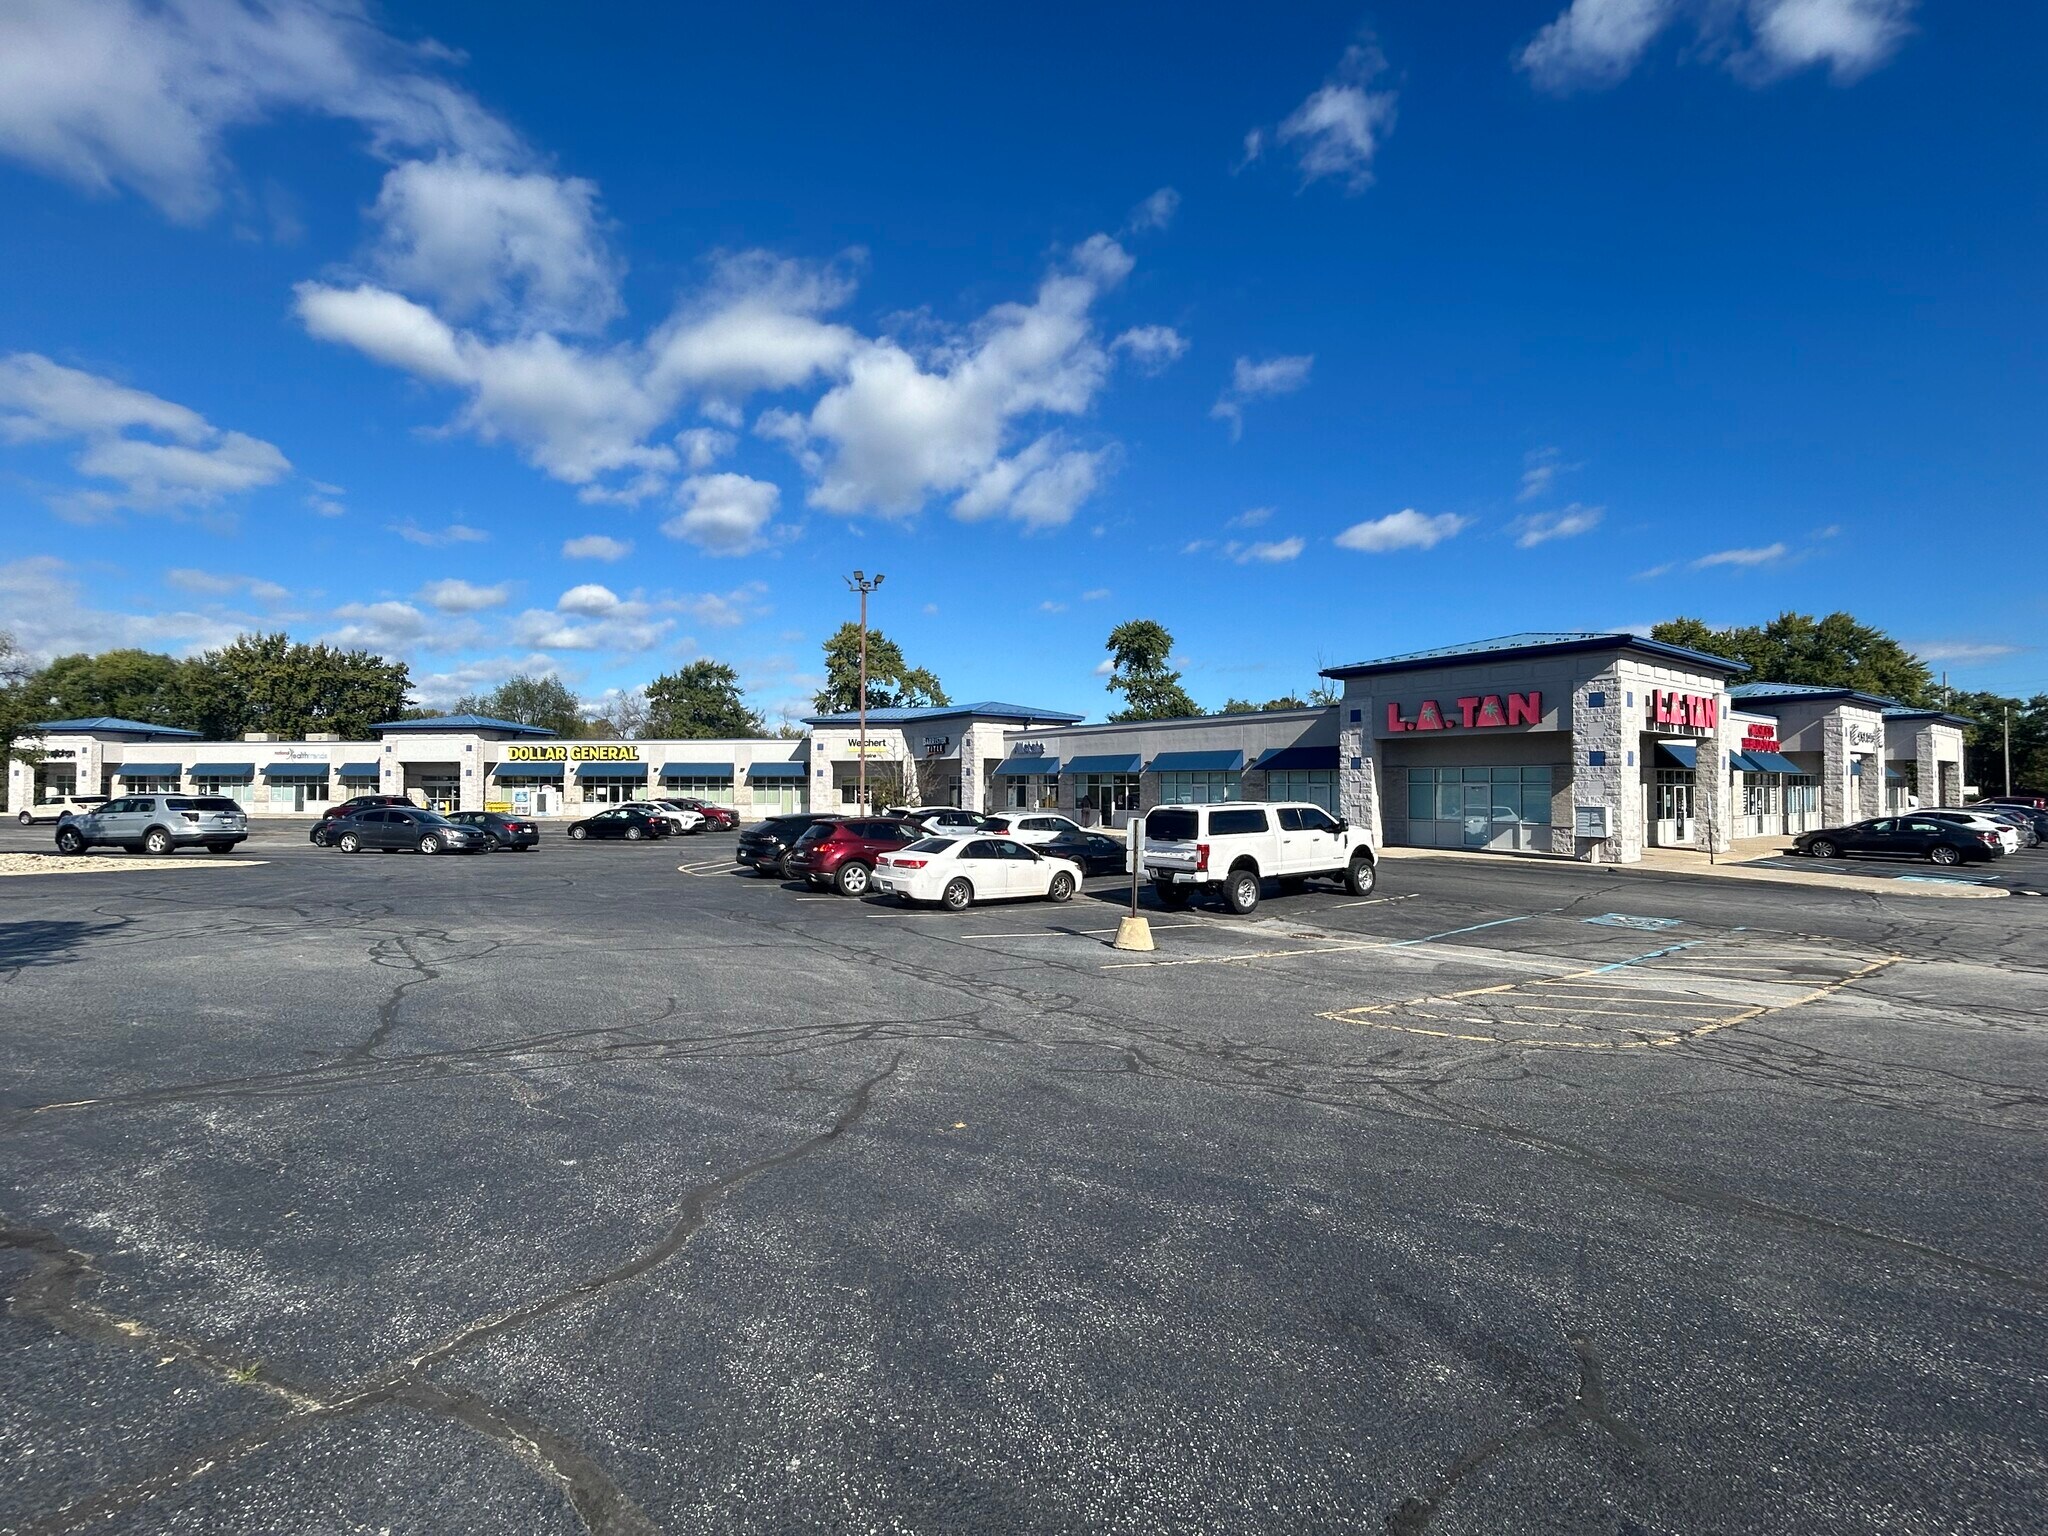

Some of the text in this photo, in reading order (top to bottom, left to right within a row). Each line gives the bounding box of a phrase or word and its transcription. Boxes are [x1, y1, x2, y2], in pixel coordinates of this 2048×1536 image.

[1387, 691, 1543, 732] L.A. TAN
[1652, 689, 1717, 729] L.A. TAN
[507, 746, 639, 762] DOLLAR GENERAL
[847, 738, 887, 747] Wechert
